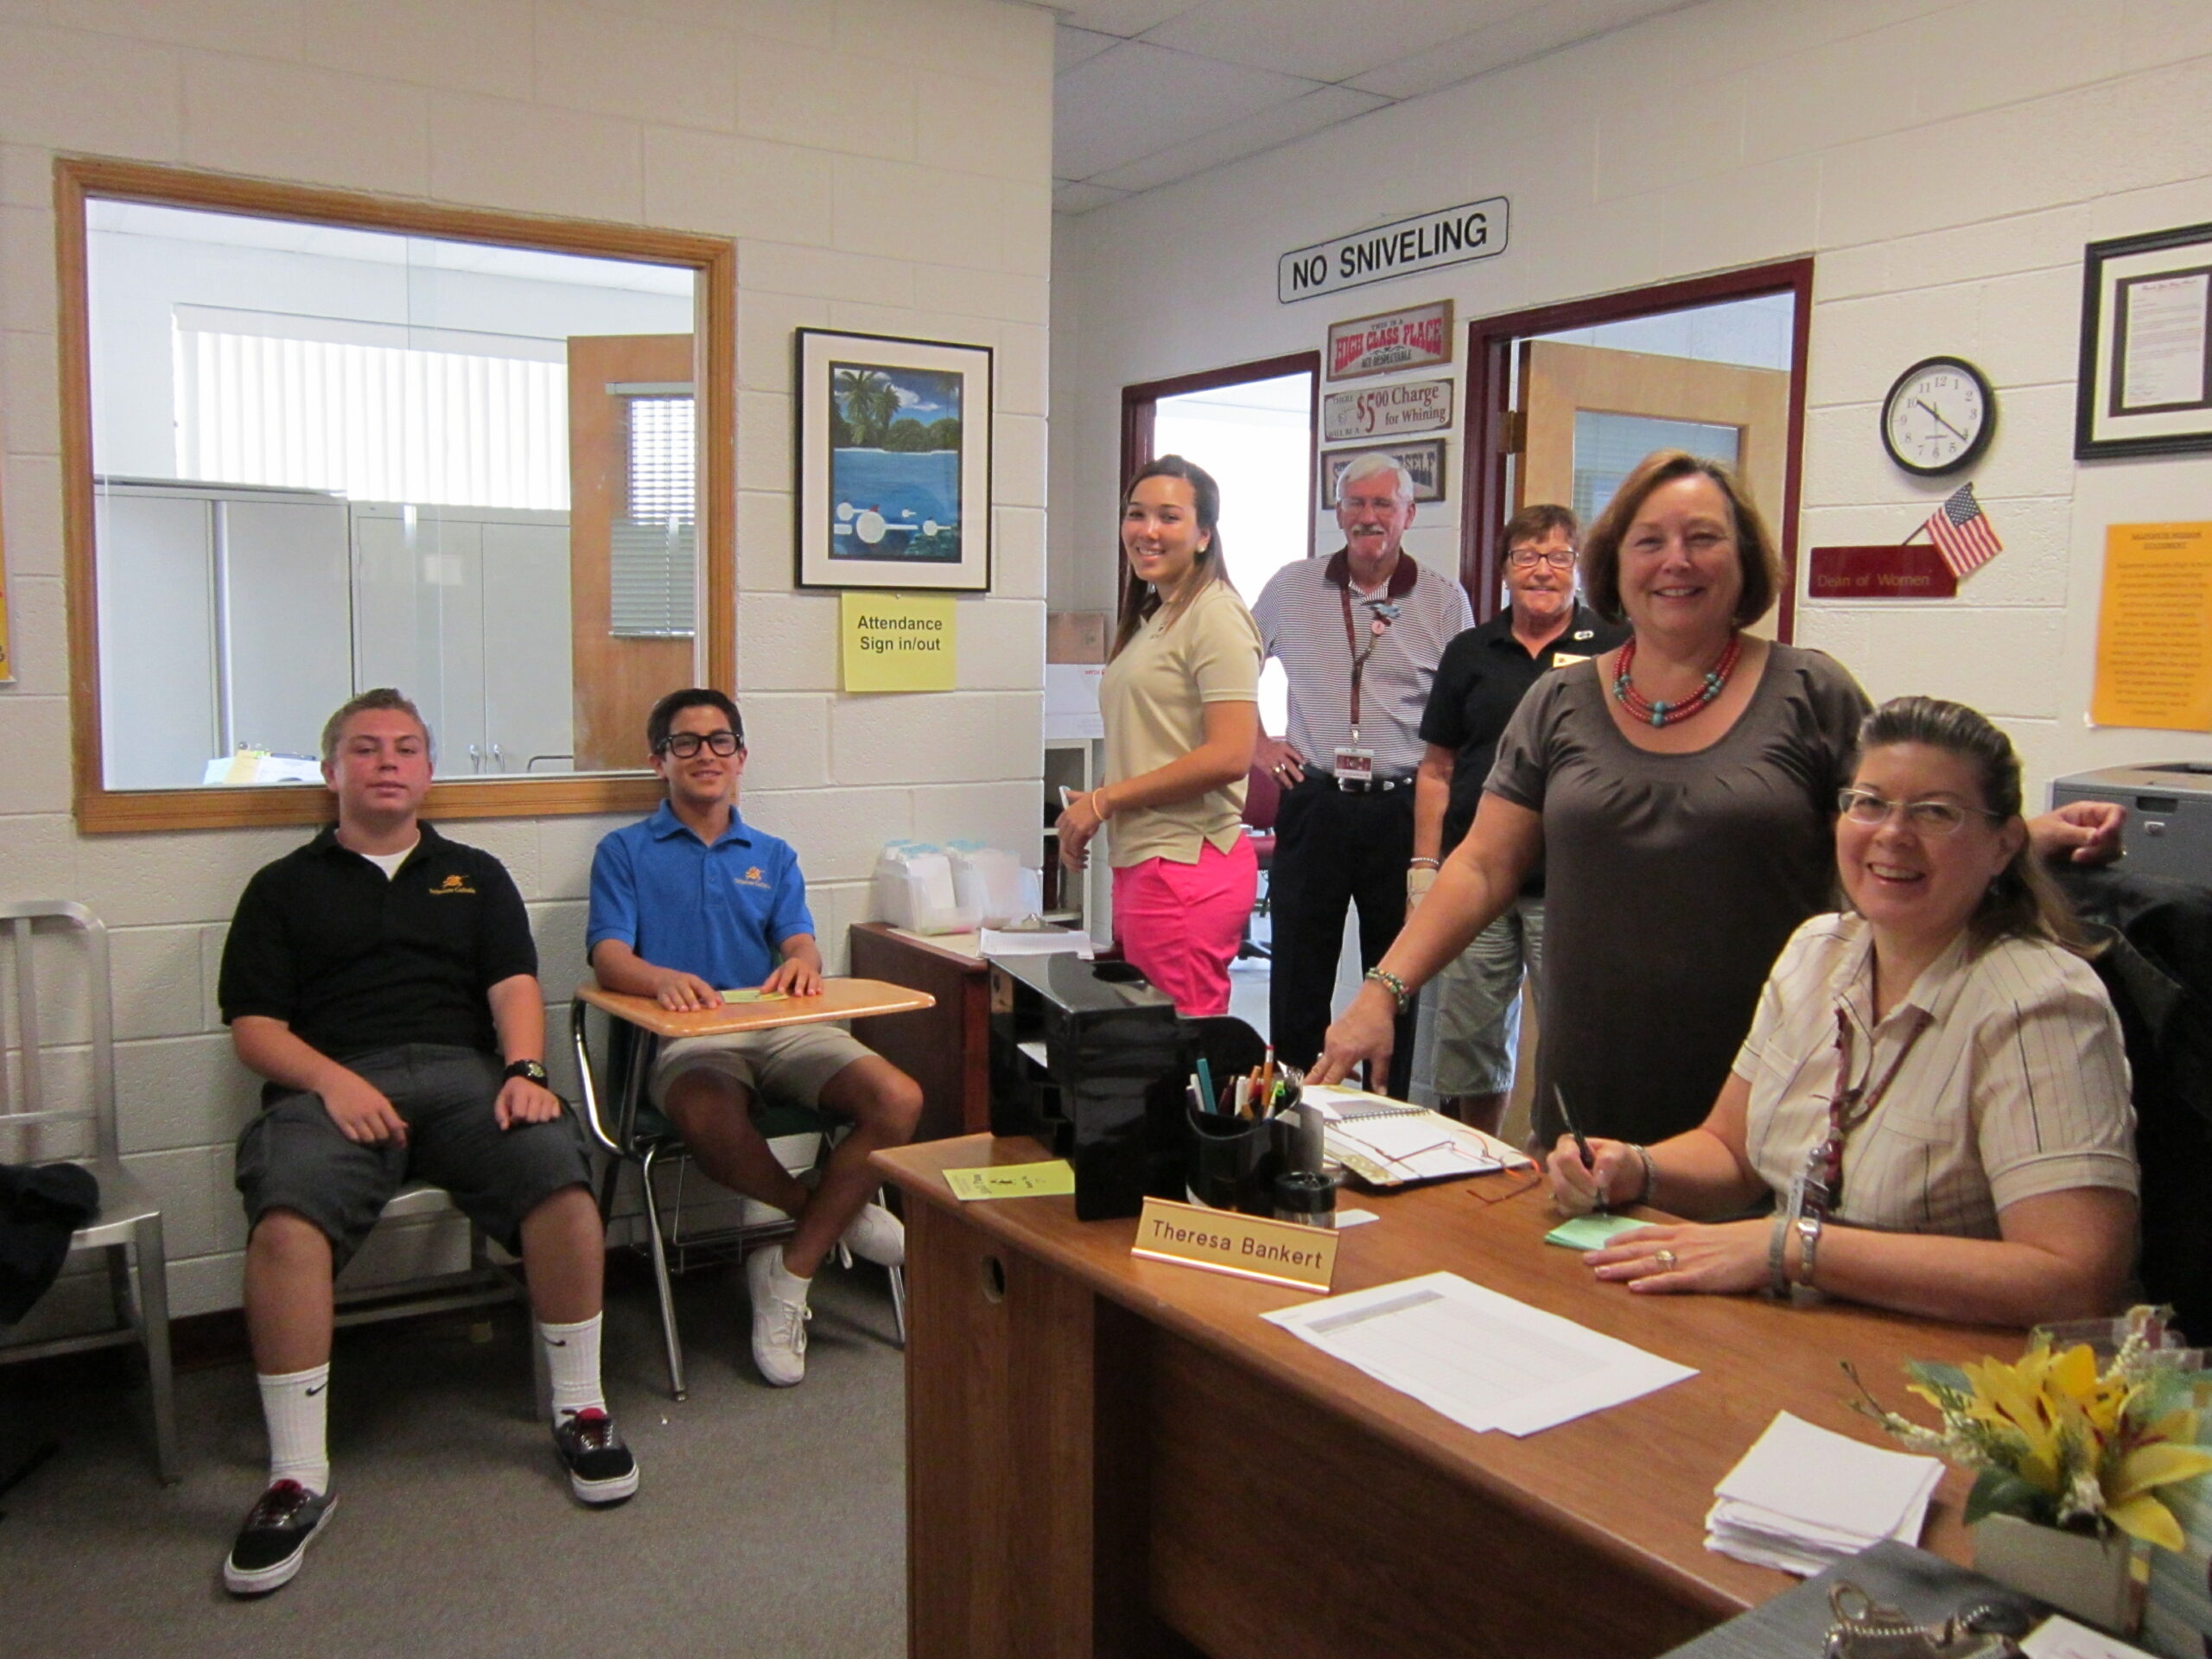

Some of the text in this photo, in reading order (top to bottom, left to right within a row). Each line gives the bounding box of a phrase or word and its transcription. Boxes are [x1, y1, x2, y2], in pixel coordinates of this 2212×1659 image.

[1293, 213, 1487, 291] NO SNIVELING
[1334, 317, 1442, 373] HIGH CLASS PLACE
[1919, 383, 1930, 393] 11
[1935, 376, 1947, 388] 12
[1954, 379, 1959, 390] 1
[1391, 385, 1440, 407] Charge
[1965, 391, 1973, 402] 2
[1385, 406, 1446, 426] for Whining
[1969, 408, 1977, 419] 3
[1817, 573, 1929, 588] Dean of Women
[857, 615, 943, 631] Attendance
[860, 636, 941, 654] Sign in/out
[1153, 1219, 1323, 1269] Theresa Bankert
